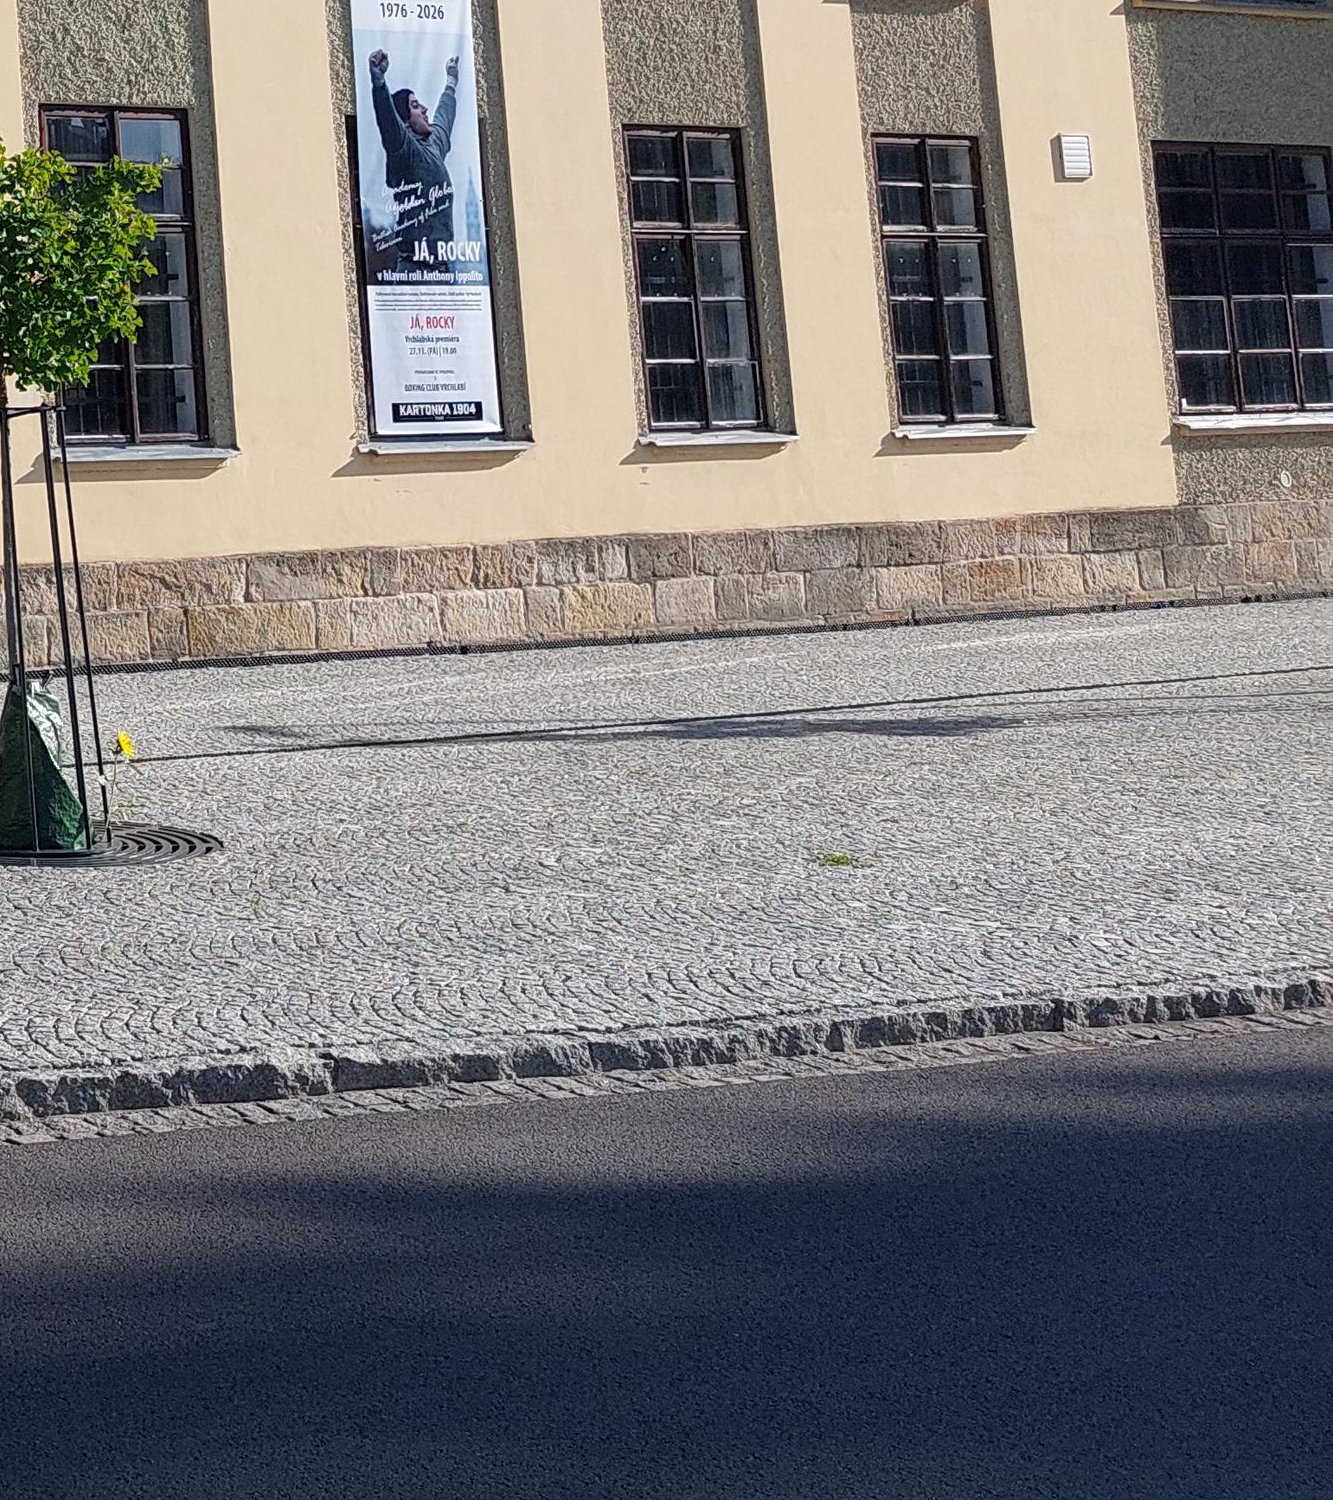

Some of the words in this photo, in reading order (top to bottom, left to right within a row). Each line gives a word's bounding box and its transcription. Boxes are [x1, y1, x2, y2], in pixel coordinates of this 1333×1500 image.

[379, 2, 408, 18] 1976
[416, 3, 445, 20] 2026
[413, 236, 434, 264] JÁ,
[437, 241, 481, 261] ROCKY
[383, 269, 408, 281] hlavní
[409, 269, 421, 281] roli
[421, 271, 453, 283] Anthony
[410, 314, 424, 331] JÁ,
[426, 316, 455, 329] ROCKY
[399, 404, 451, 416] KARTONKA
[452, 403, 476, 415] 1904
